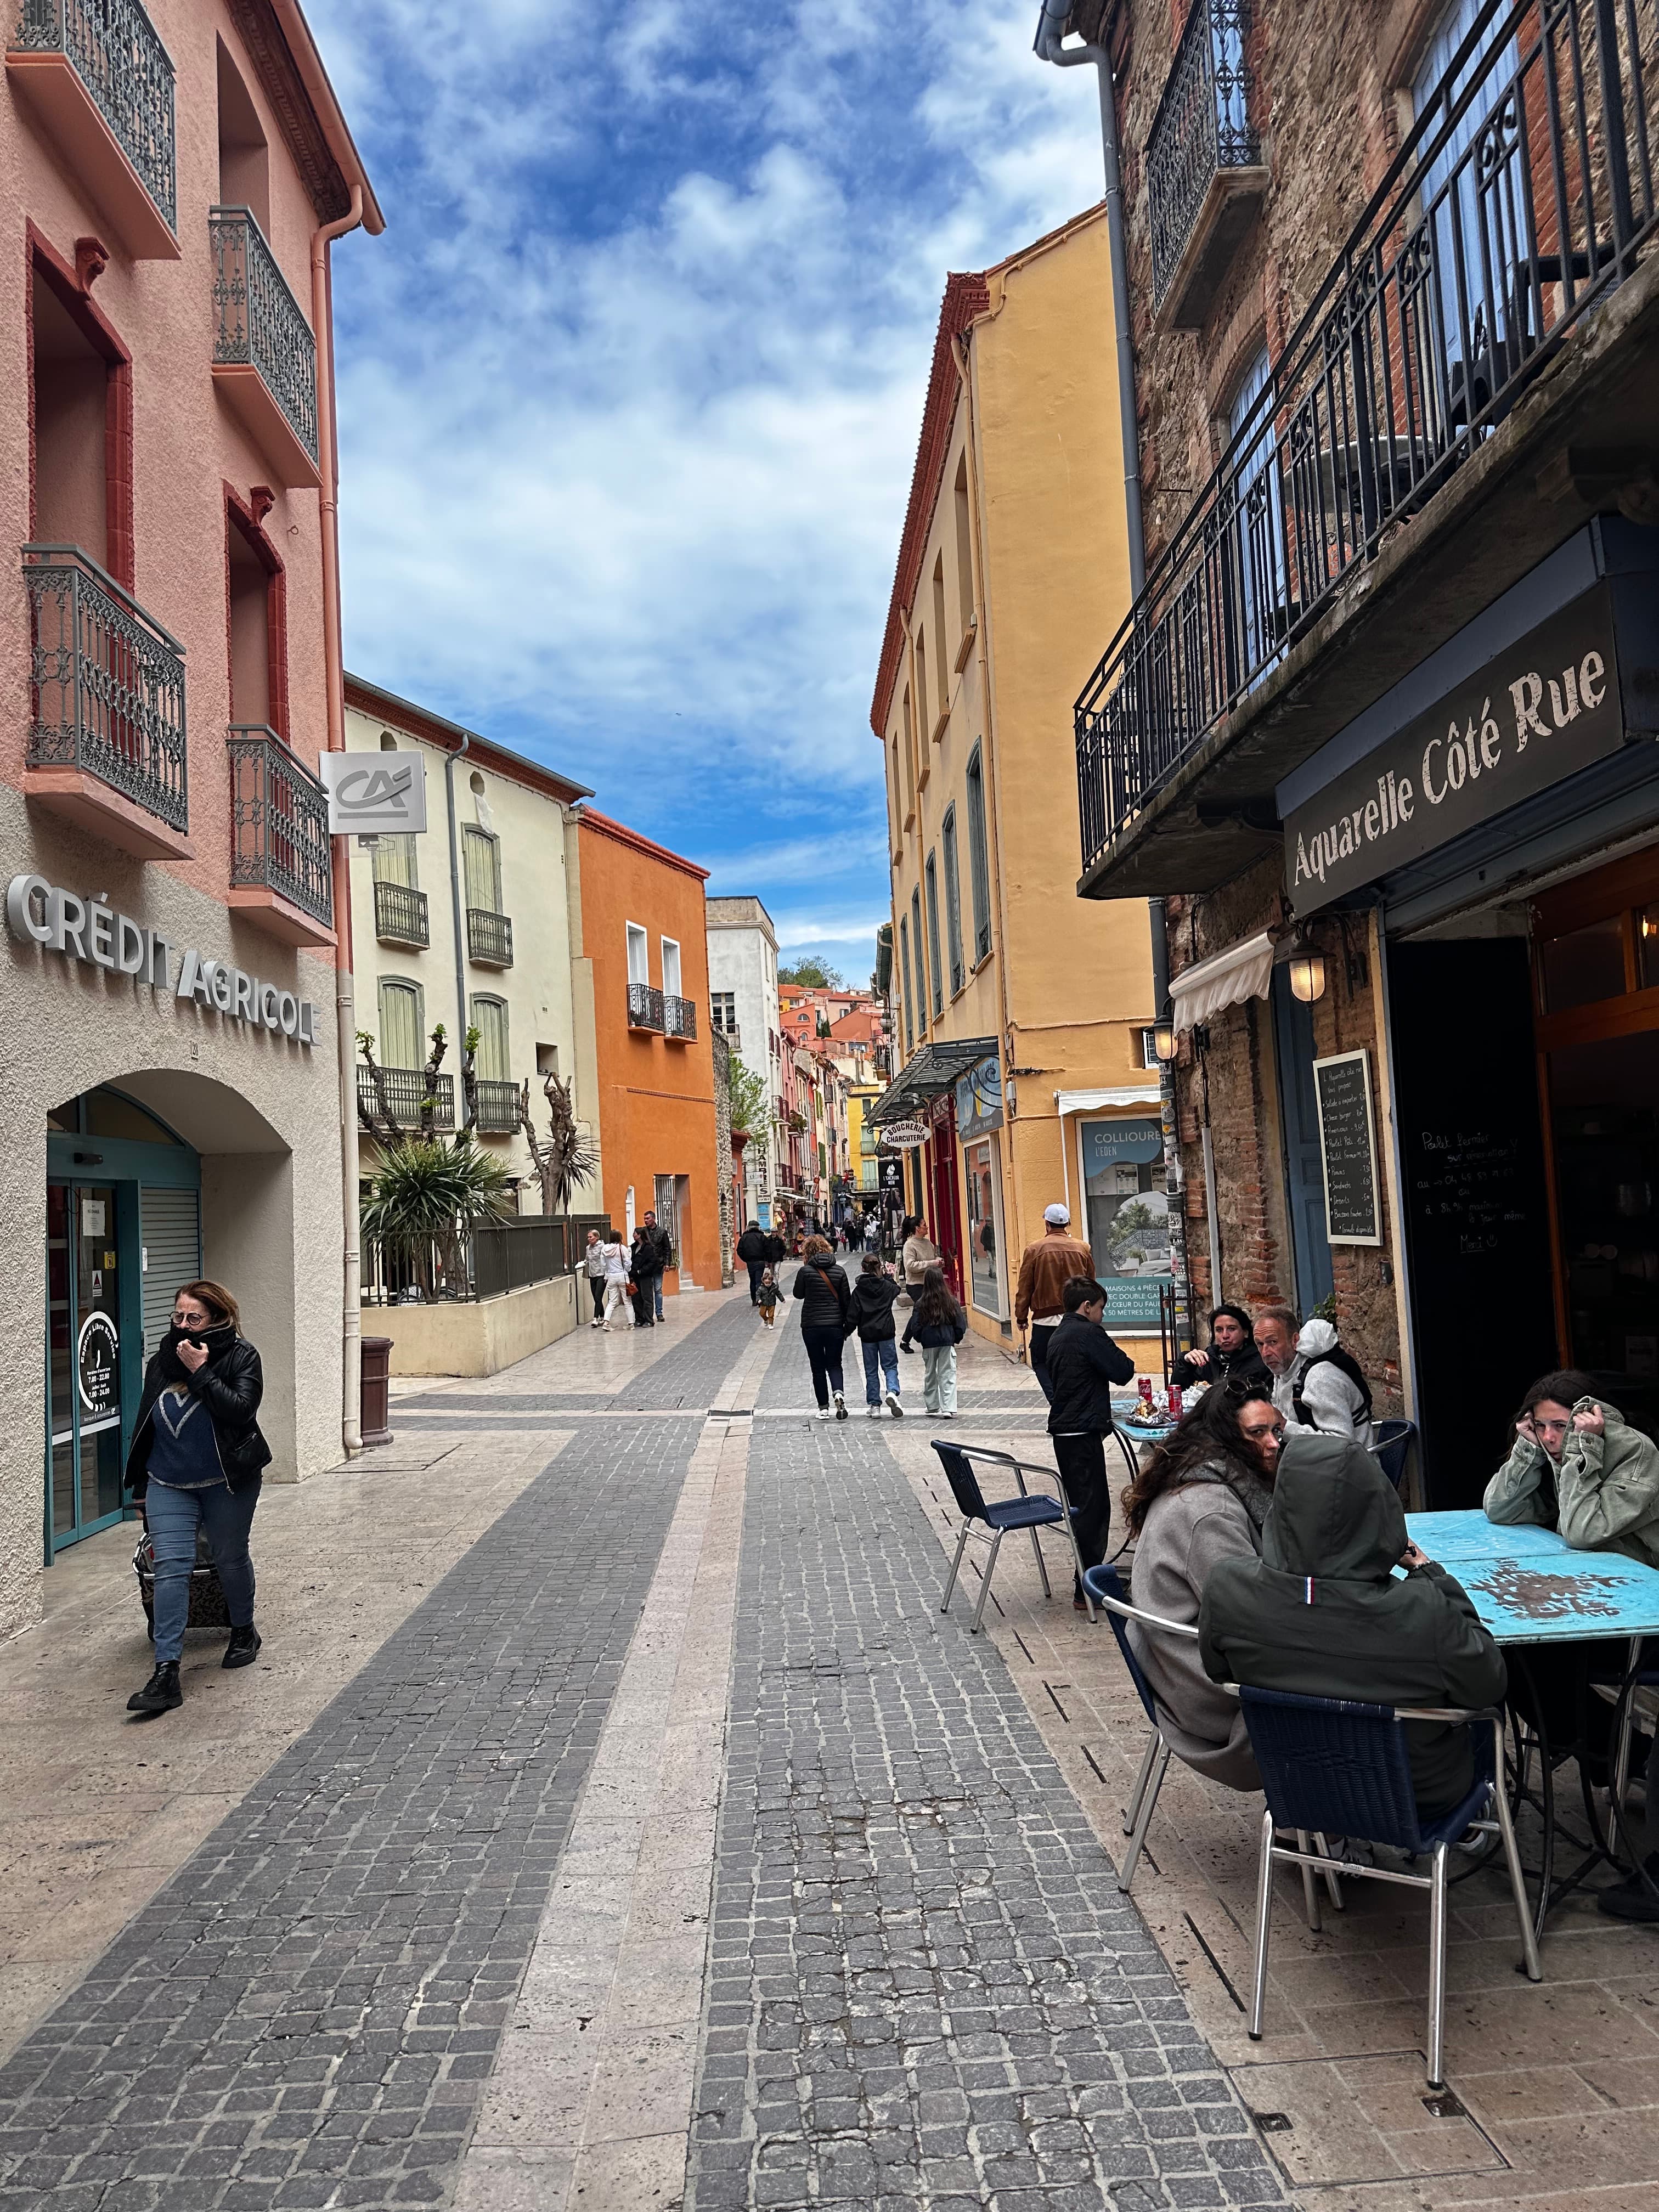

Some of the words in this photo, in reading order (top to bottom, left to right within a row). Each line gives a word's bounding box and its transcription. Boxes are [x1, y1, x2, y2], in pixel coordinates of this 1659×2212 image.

[1294, 770, 1414, 886] Aquarelle
[1422, 696, 1502, 804] Côté
[1508, 651, 1607, 753] Rue
[8, 874, 177, 989] CRÉDIT
[177, 949, 322, 1047] AGRICOLE
[887, 1122, 926, 1136] BOUCHERIE
[887, 1134, 926, 1143] CHARCUTERIE
[1094, 1131, 1161, 1144] COLLIOURE
[1422, 1132, 1453, 1150] Poulet
[1096, 1146, 1117, 1157] L'EDEN
[1447, 1154, 1462, 1164] sur
[1417, 1180, 1431, 1189] au
[1458, 1188, 1470, 1196] ou
[1460, 1234, 1482, 1252] Merci
[81, 1330, 92, 1363] Espace
[92, 1323, 104, 1332] Libre
[105, 1327, 115, 1359] Service
